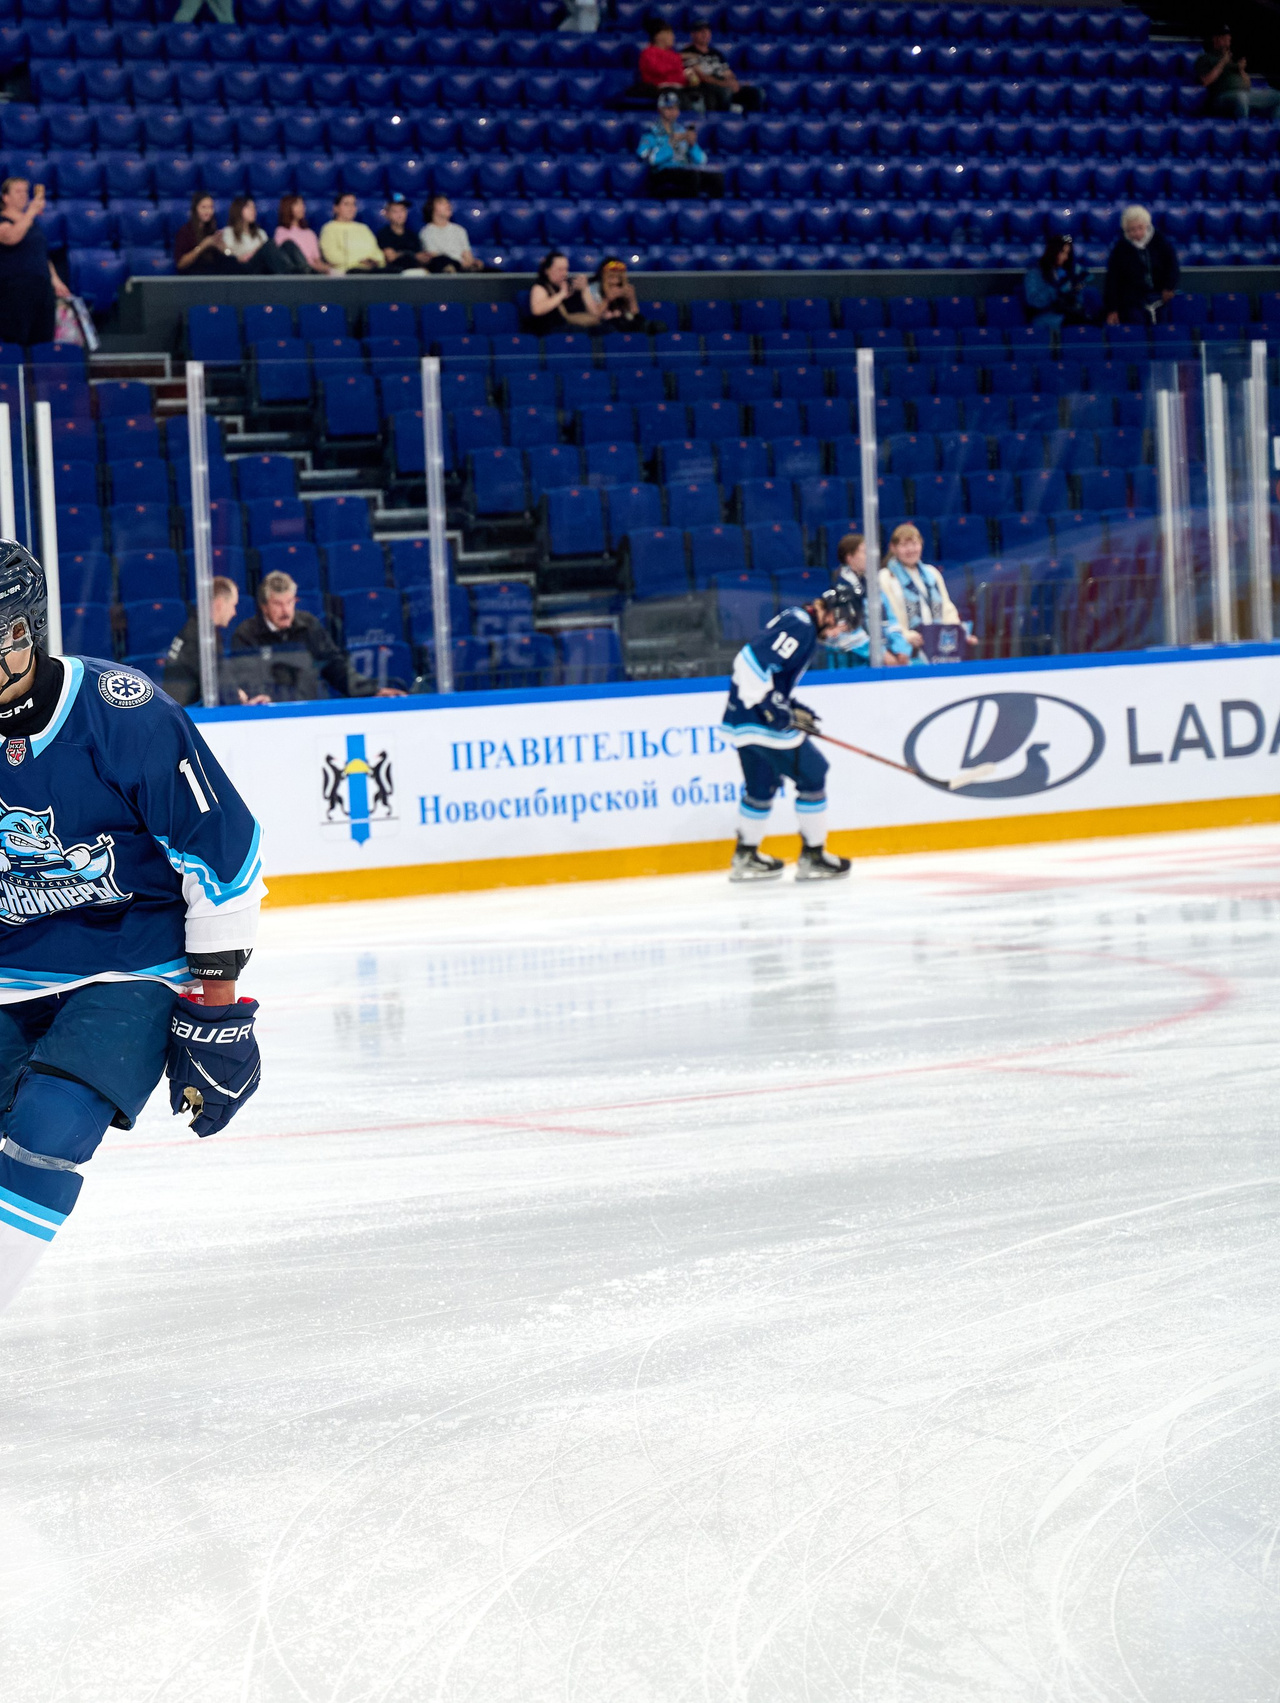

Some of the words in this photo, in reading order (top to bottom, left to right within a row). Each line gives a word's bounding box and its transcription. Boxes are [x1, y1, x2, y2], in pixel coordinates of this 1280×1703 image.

[771, 631, 799, 660] 19
[451, 726, 738, 771] ПРАВИТЕЛЬСТВ
[418, 780, 659, 825] Новосибирской
[9, 876, 78, 887] СИБИРСКИЕ
[190, 967, 223, 976] BAUER
